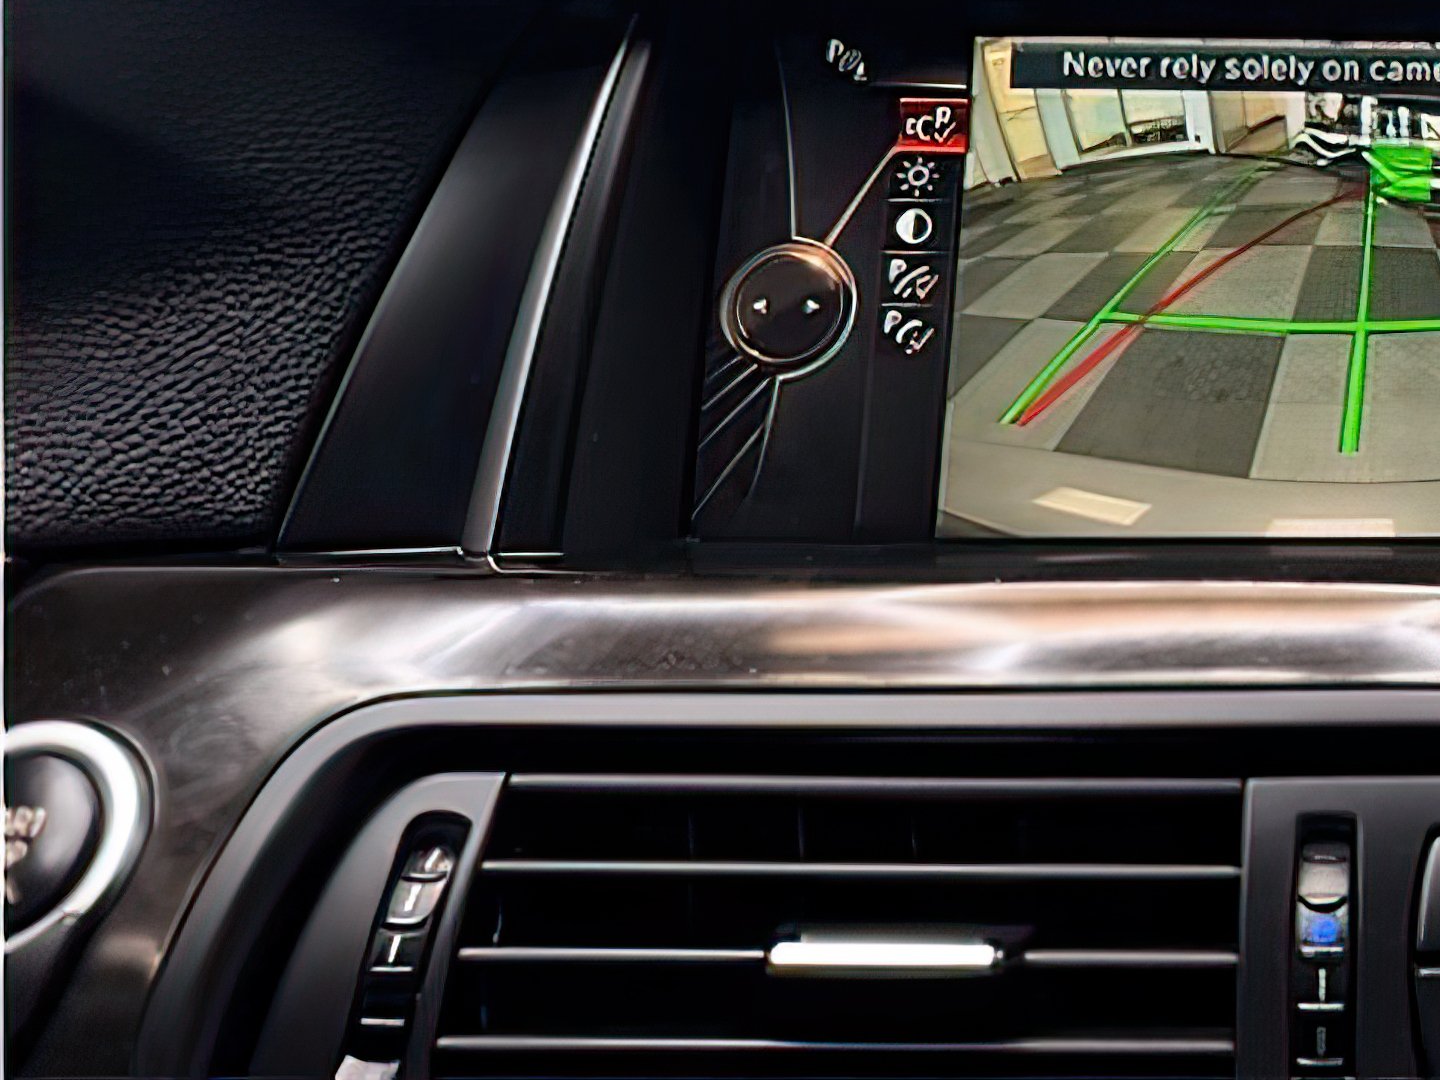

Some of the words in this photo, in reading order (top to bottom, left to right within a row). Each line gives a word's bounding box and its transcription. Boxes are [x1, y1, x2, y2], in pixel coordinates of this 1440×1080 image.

[1063, 51, 1152, 78] Never
[1160, 53, 1216, 84] rely
[1224, 54, 1315, 86] solely
[1322, 59, 1360, 82] on
